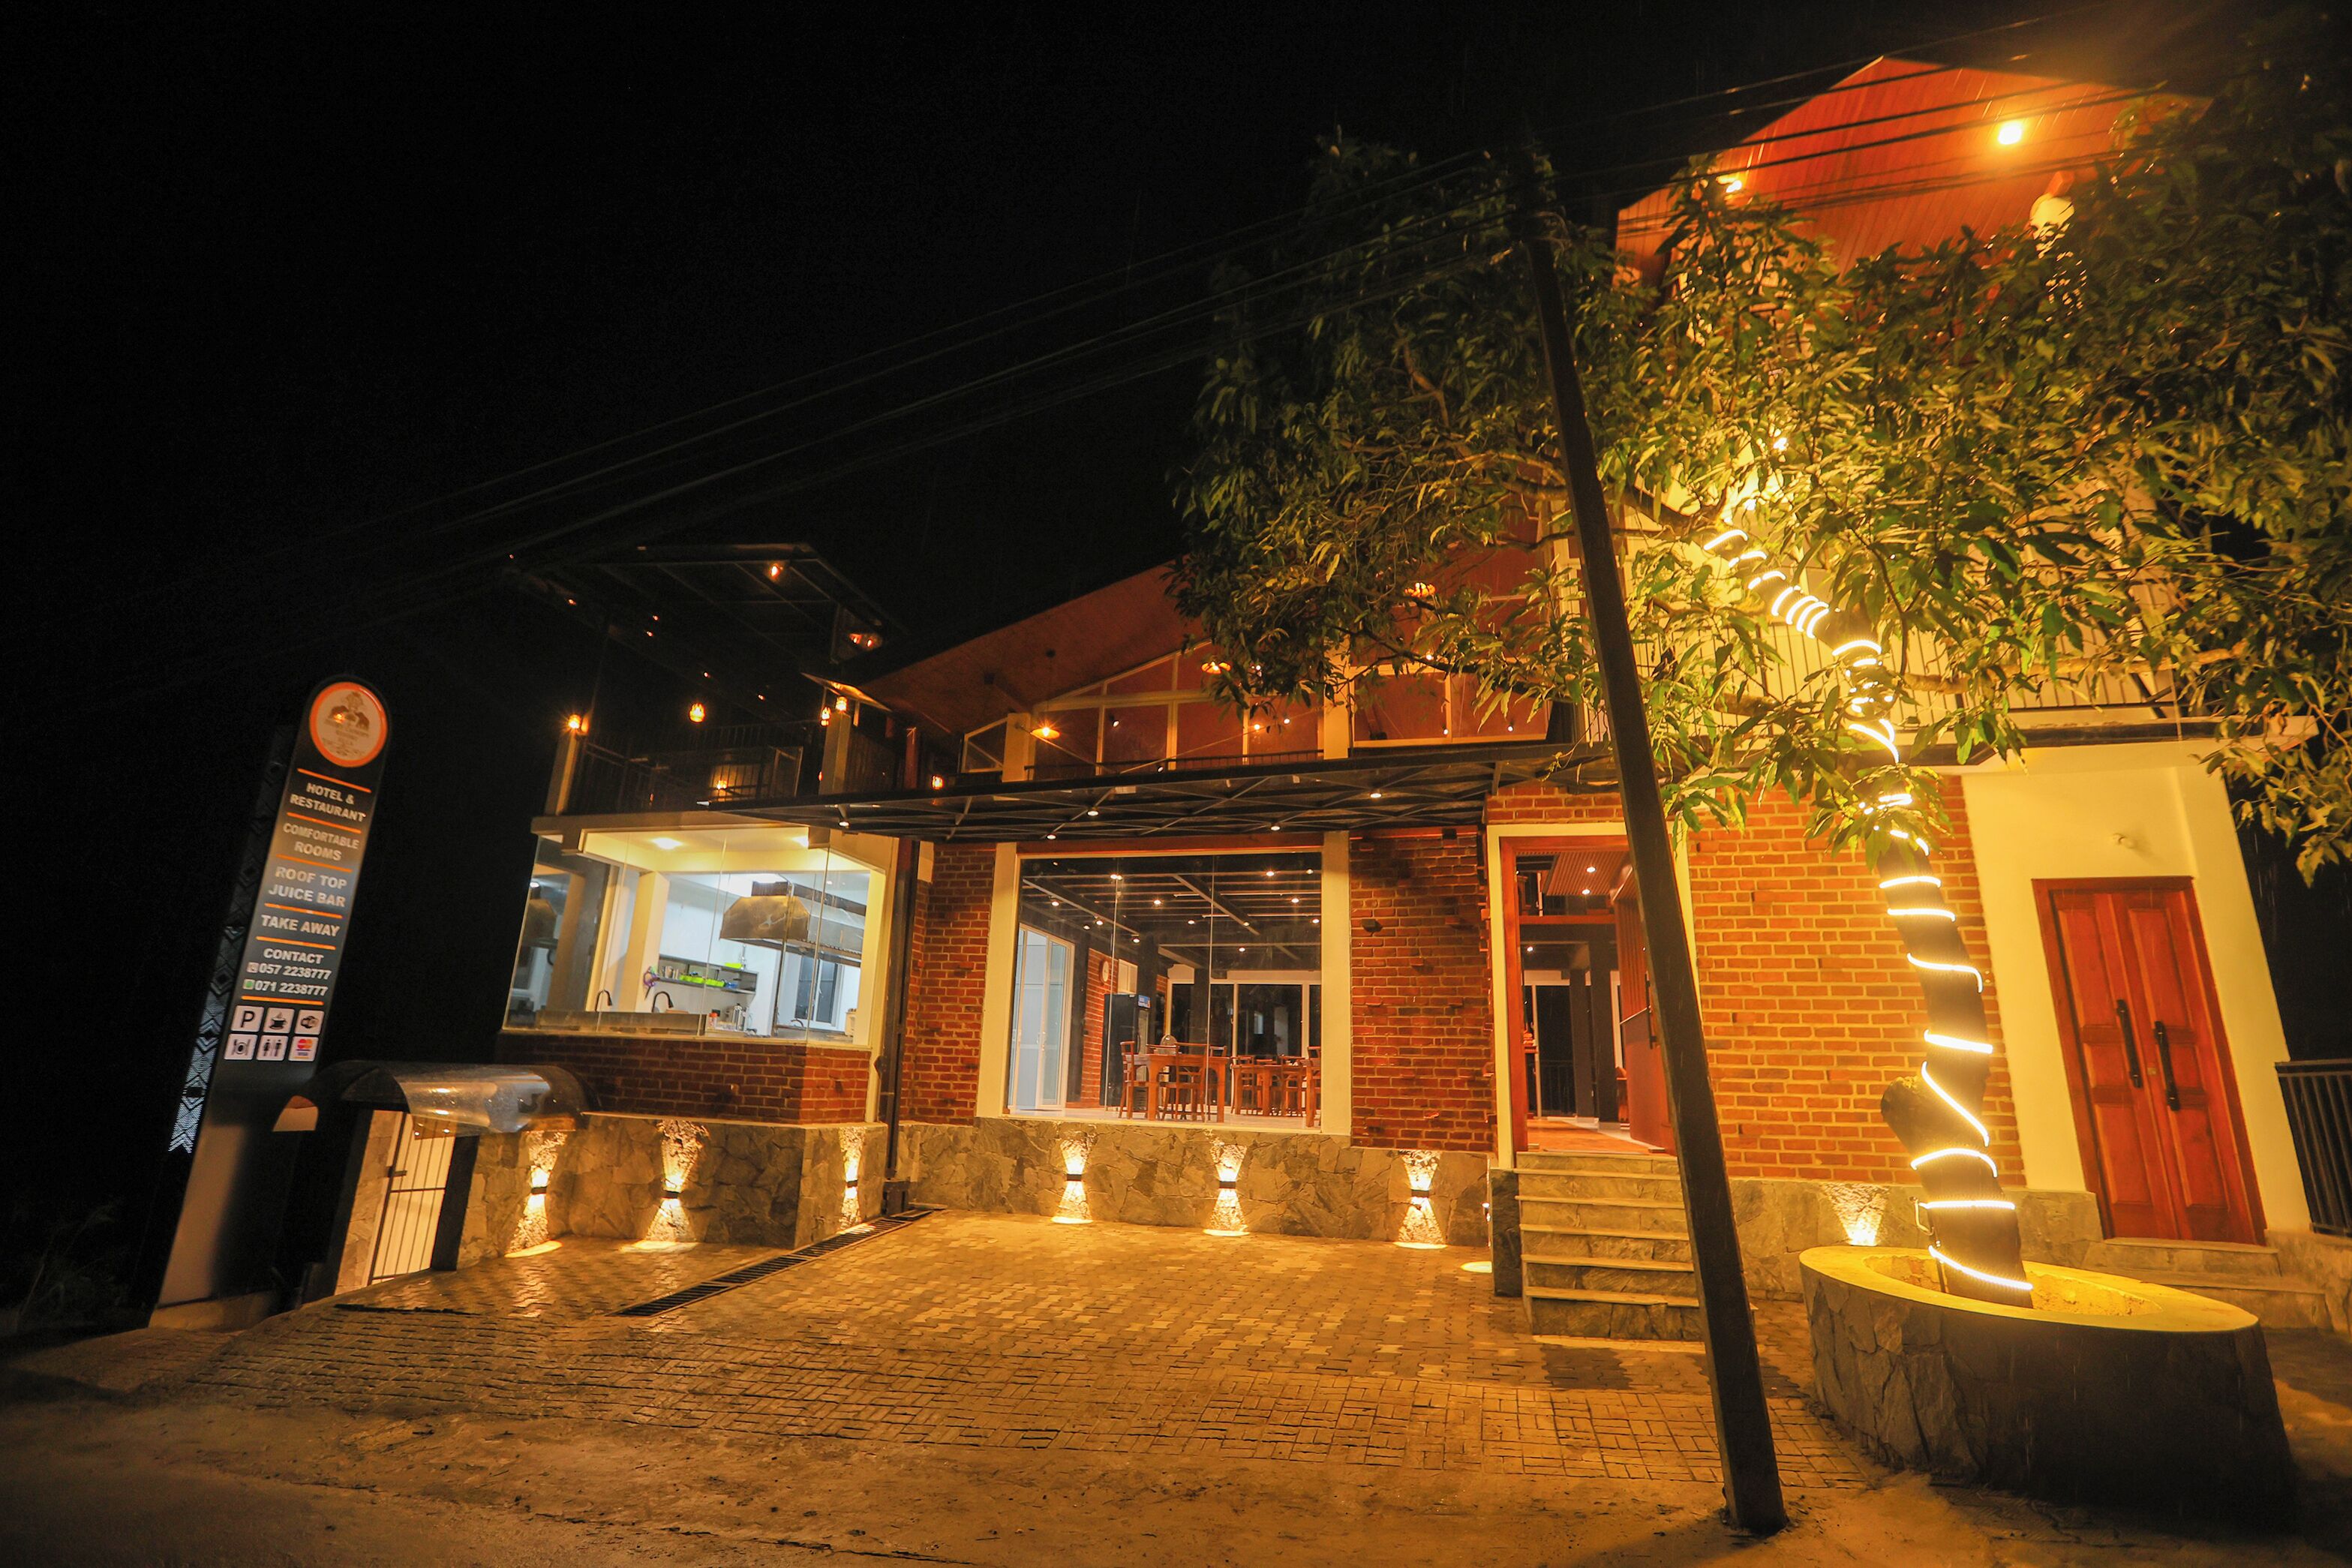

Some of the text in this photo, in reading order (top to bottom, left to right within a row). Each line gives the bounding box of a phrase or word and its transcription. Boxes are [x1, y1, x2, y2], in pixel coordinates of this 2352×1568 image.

[306, 782, 355, 805] HOTEL &
[290, 794, 366, 822] RESTAURANT
[283, 823, 360, 849] COMFORTABLE
[294, 841, 342, 861] ROOMS
[275, 866, 347, 889] ROOF TOP
[269, 884, 346, 908] JUICE BAR
[261, 914, 340, 938] TAKE AWAY
[263, 948, 324, 964] CONTACT
[259, 963, 282, 975] 057
[255, 980, 277, 992] 071
